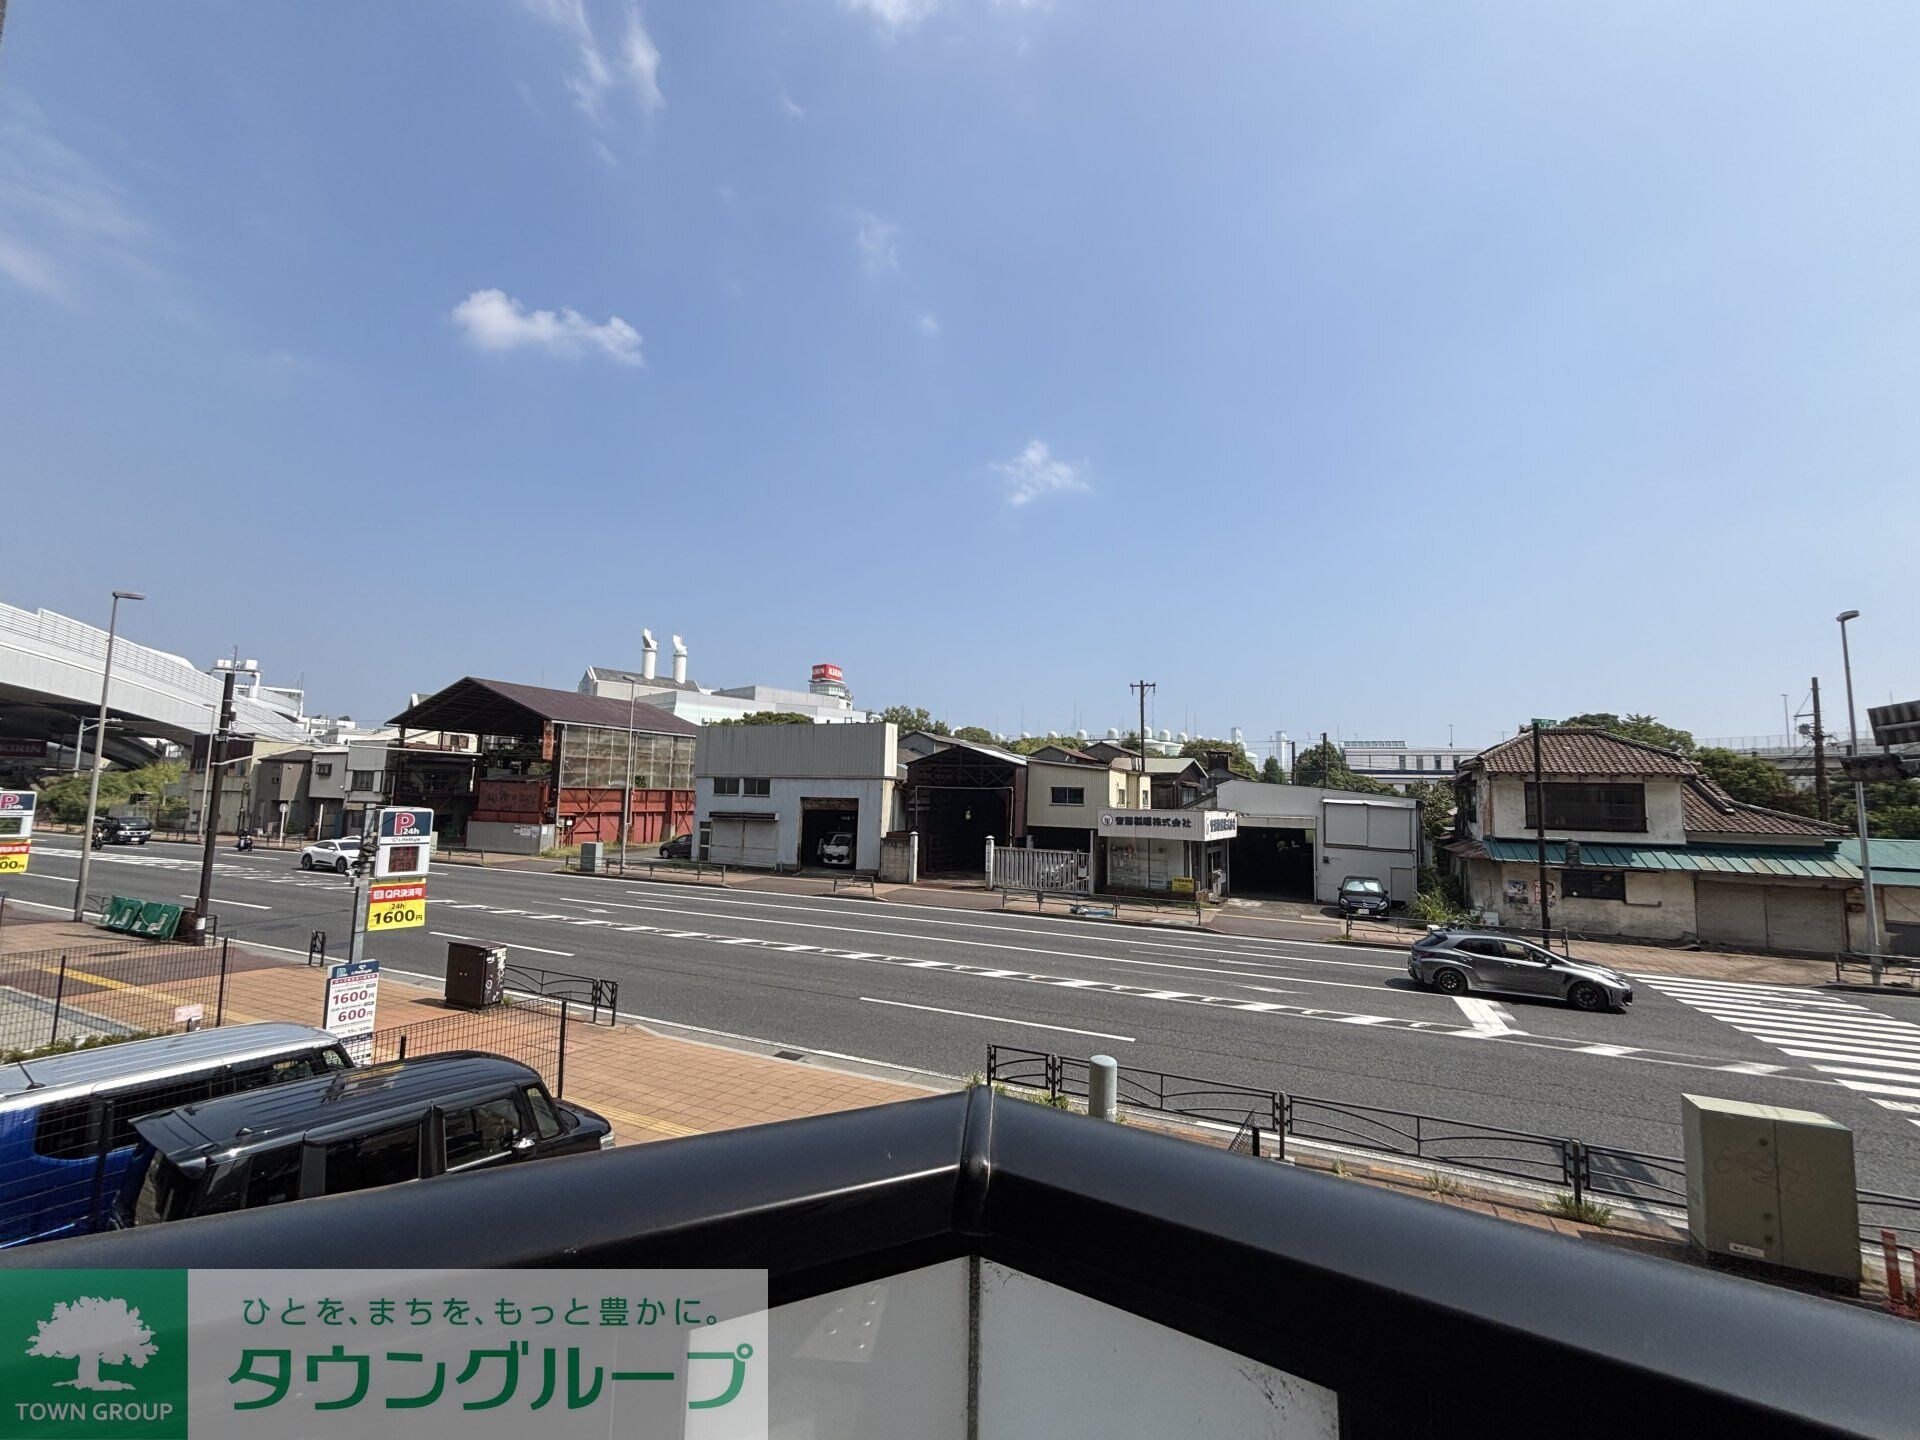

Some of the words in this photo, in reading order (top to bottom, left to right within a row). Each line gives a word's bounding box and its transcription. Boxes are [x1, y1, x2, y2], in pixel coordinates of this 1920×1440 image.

[394, 812, 415, 835] P
[390, 902, 405, 910] 24h
[374, 910, 422, 924] 1600円
[333, 990, 374, 1005] 1600円
[338, 1008, 373, 1021] 600円
